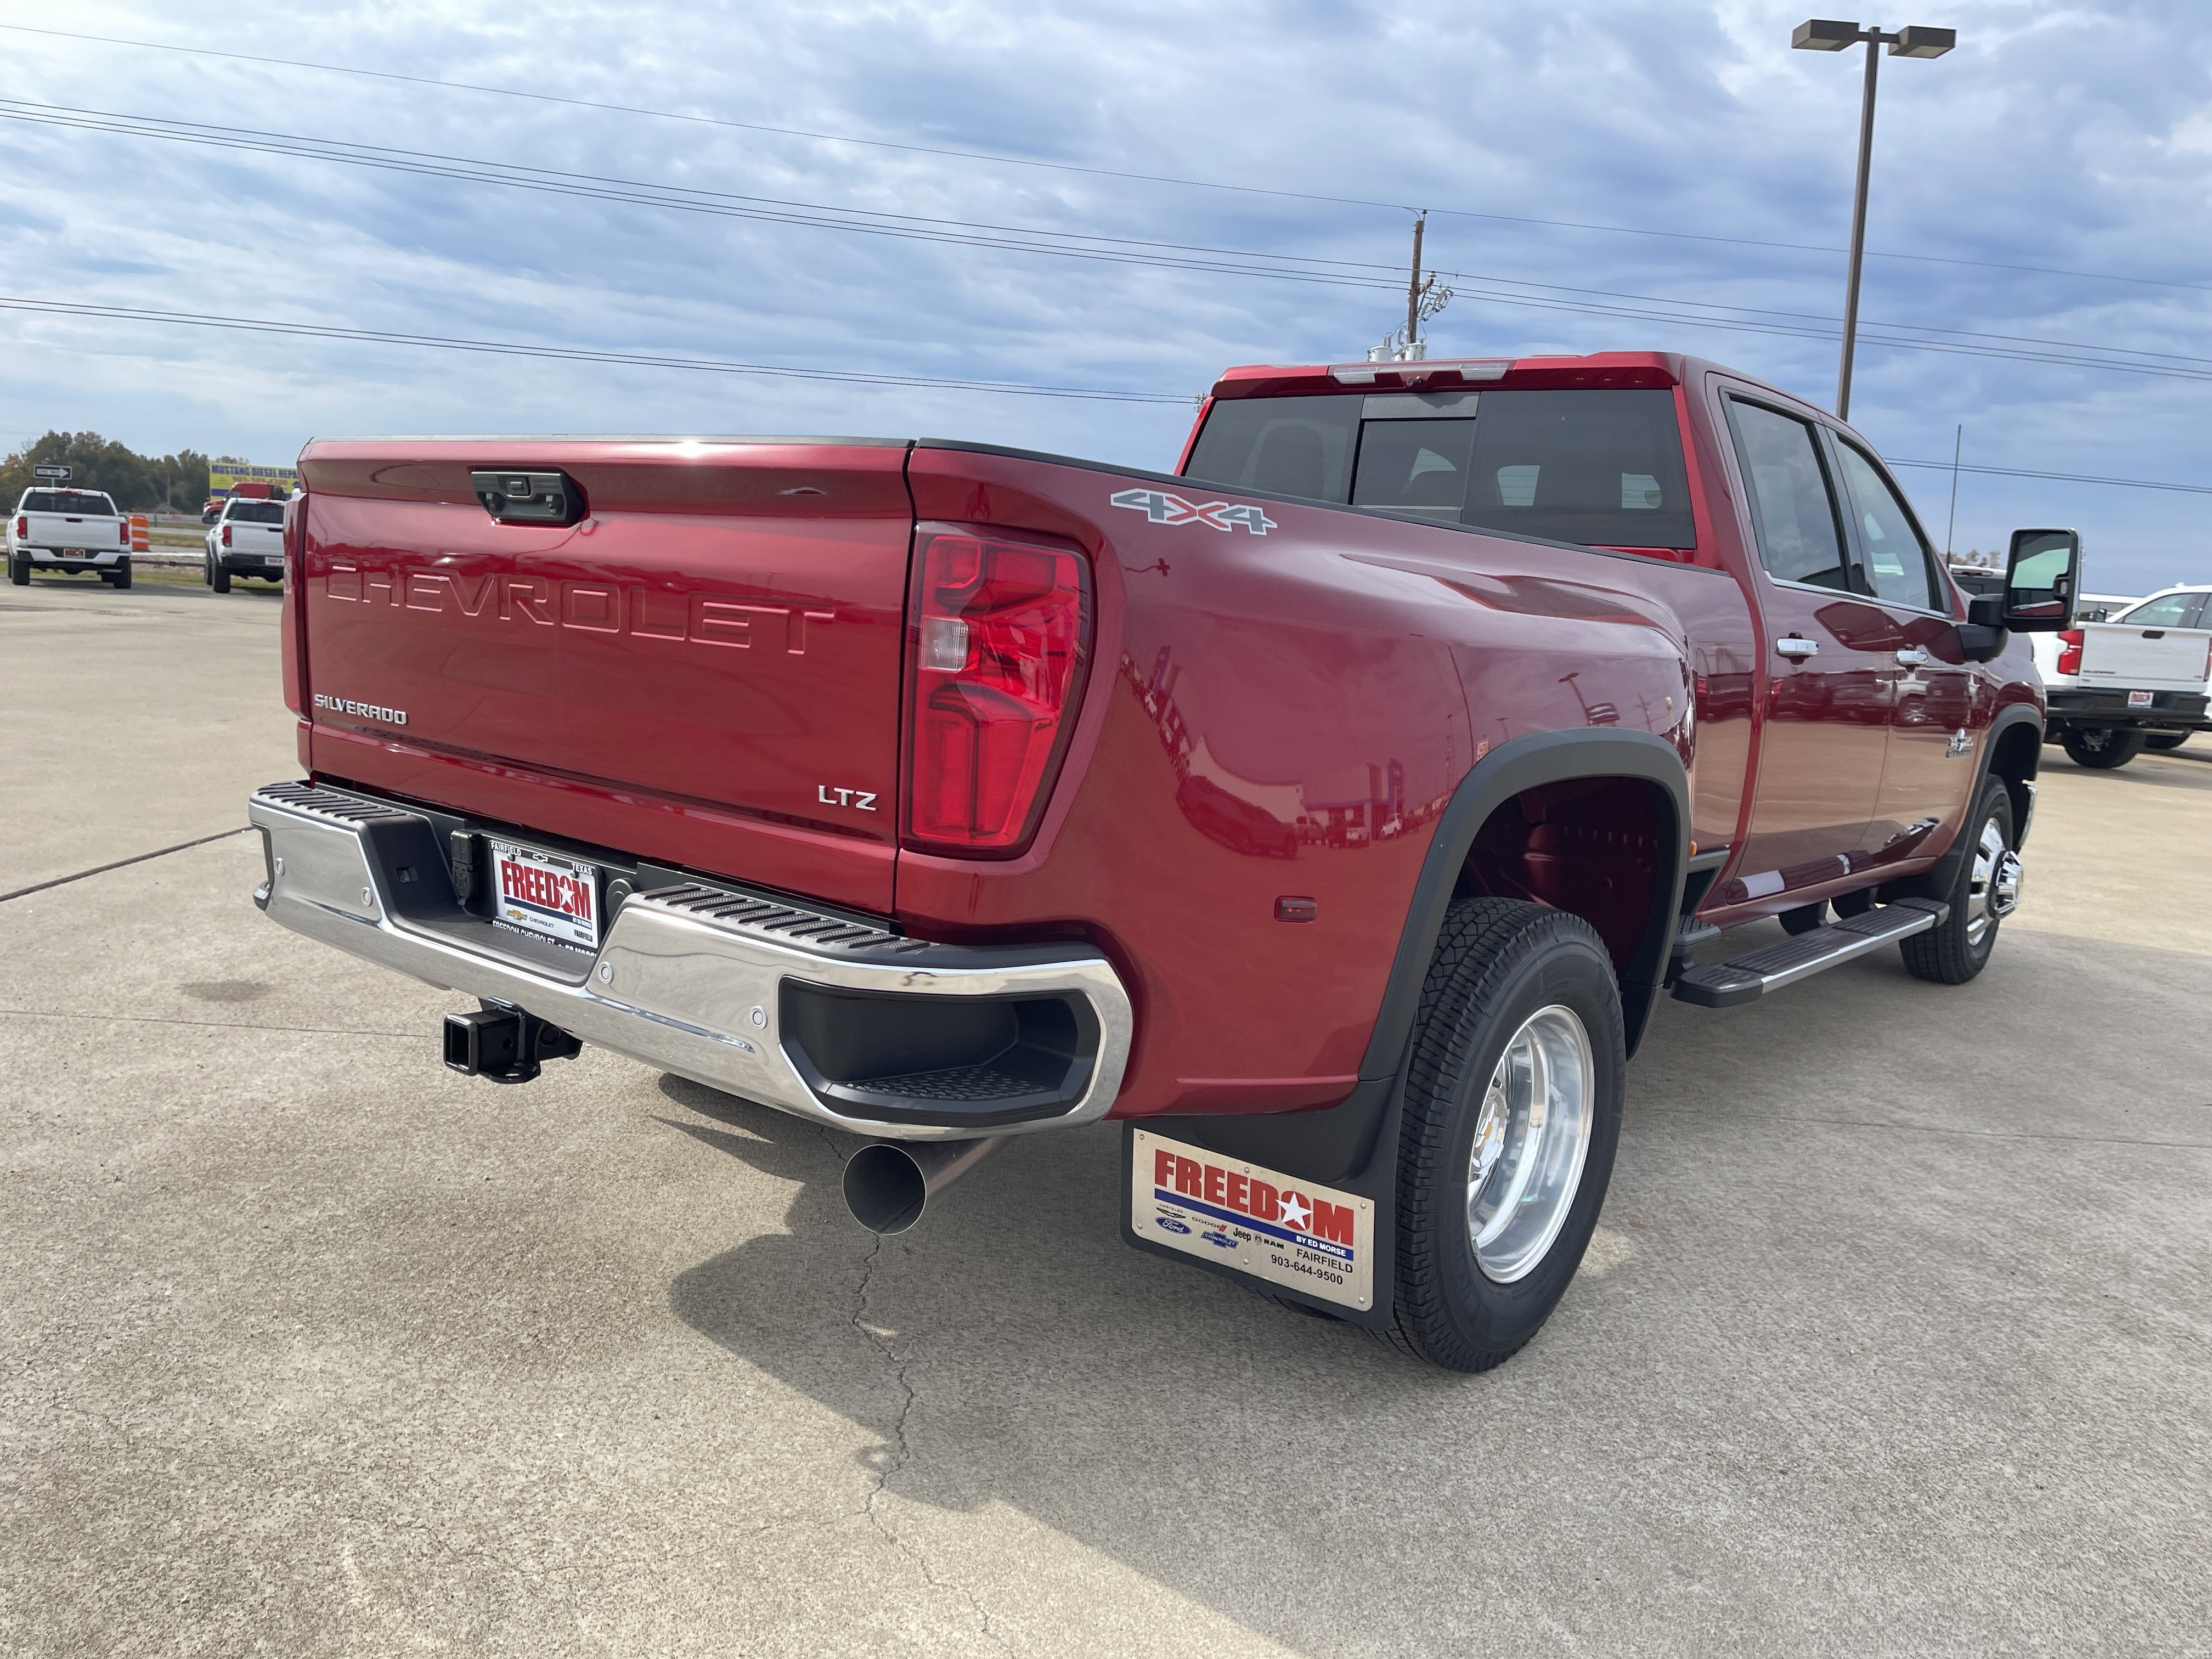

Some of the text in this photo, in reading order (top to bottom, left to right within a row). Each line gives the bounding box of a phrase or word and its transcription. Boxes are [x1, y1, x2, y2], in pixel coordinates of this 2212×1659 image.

[212, 465, 250, 476] MUSTANG
[252, 467, 276, 477] DIESEL
[326, 558, 835, 655] CHEVROLET
[314, 693, 407, 725] SILVERADO
[818, 785, 878, 811] LTZ
[491, 842, 592, 875] FAIRFIELD TEXAS
[501, 859, 591, 921] FREEDOM
[529, 917, 554, 928] CHEVROLET
[1154, 1148, 1355, 1247] FREEDOM
[1159, 1203, 1183, 1214] CHRYSLER
[1162, 1218, 1184, 1233] Ford
[1233, 1227, 1251, 1242] Jeep
[1204, 1233, 1235, 1246] CHEVROLET
[1263, 1238, 1284, 1250] RAM
[1296, 1235, 1346, 1257] BY ED MORSE
[1271, 1254, 1343, 1285] 903-644-9500
[1296, 1248, 1353, 1273] FAIRFIELD
